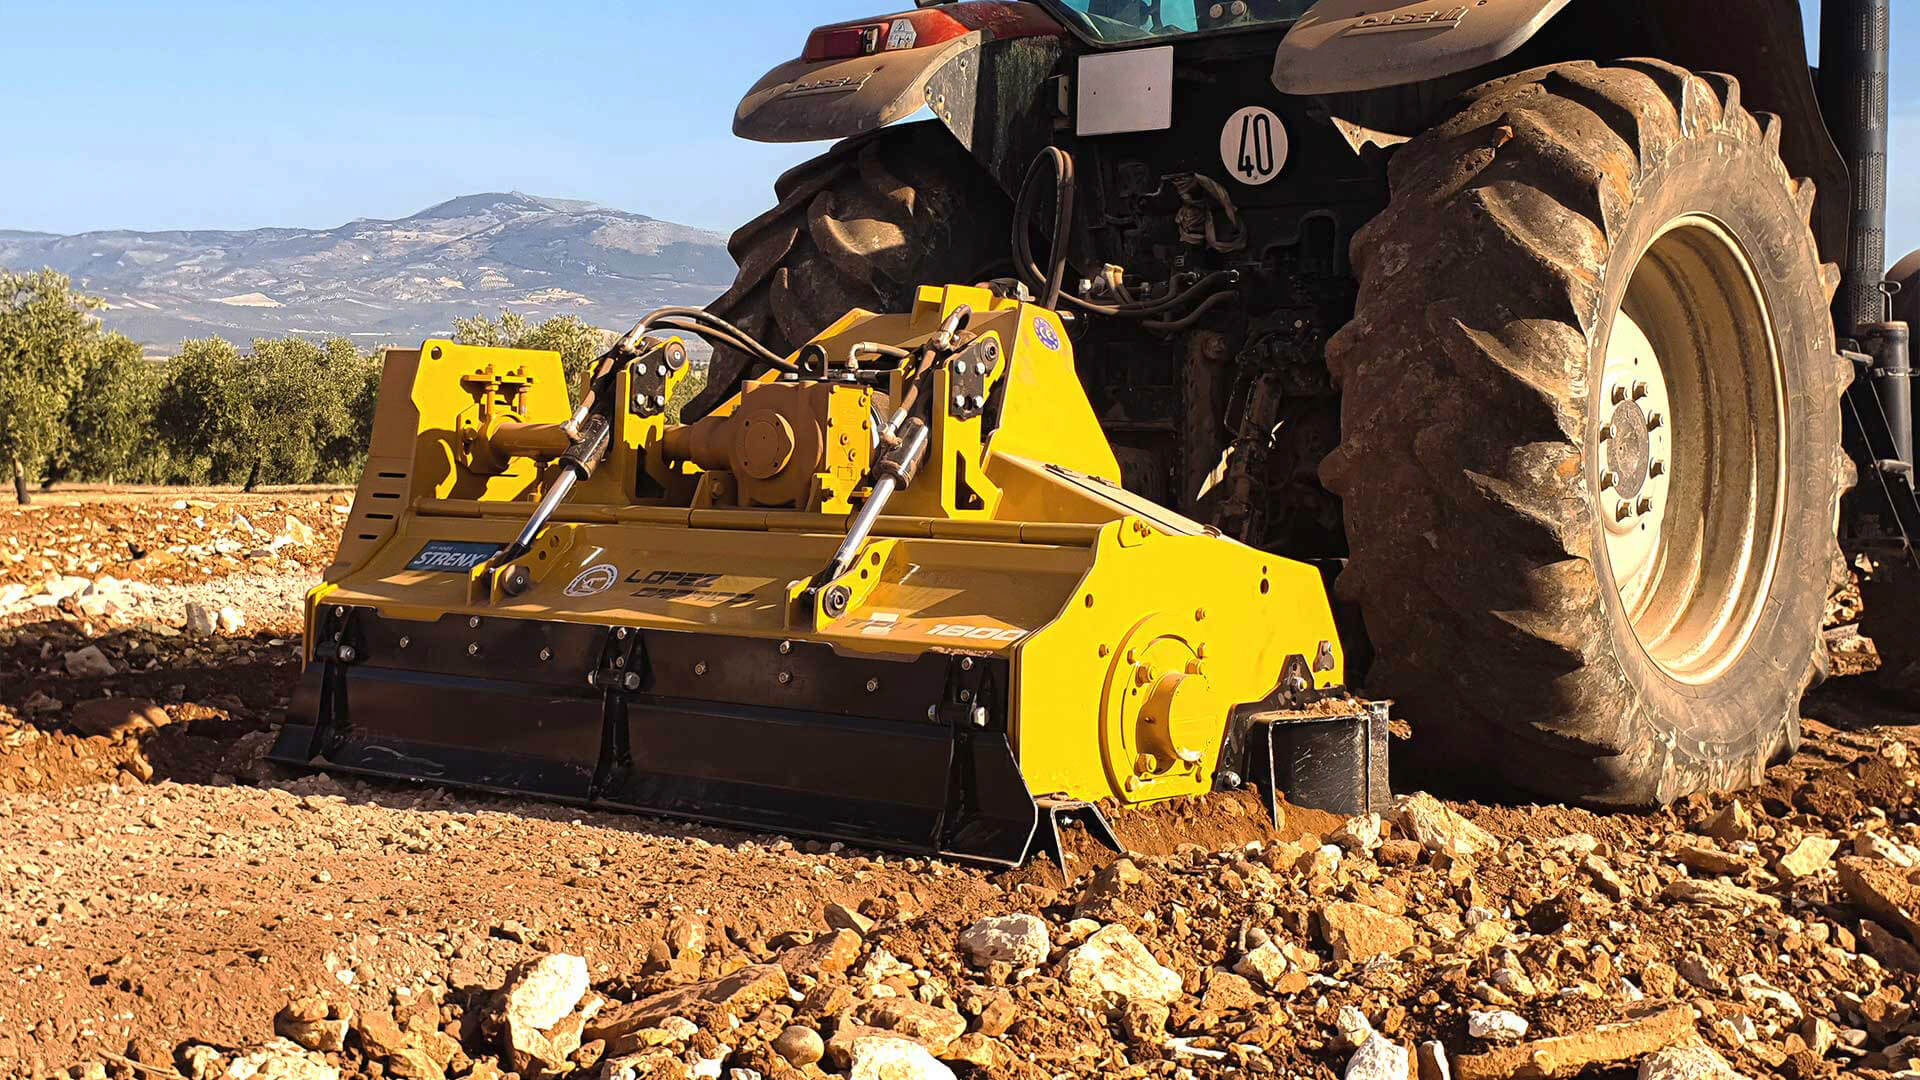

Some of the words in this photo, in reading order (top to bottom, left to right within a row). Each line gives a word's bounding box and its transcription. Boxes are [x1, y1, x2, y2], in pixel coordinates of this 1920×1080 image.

[1237, 113, 1274, 178] 40
[413, 551, 483, 567] STRENX
[624, 569, 723, 587] LOPEZ
[925, 624, 1028, 641] 1800
